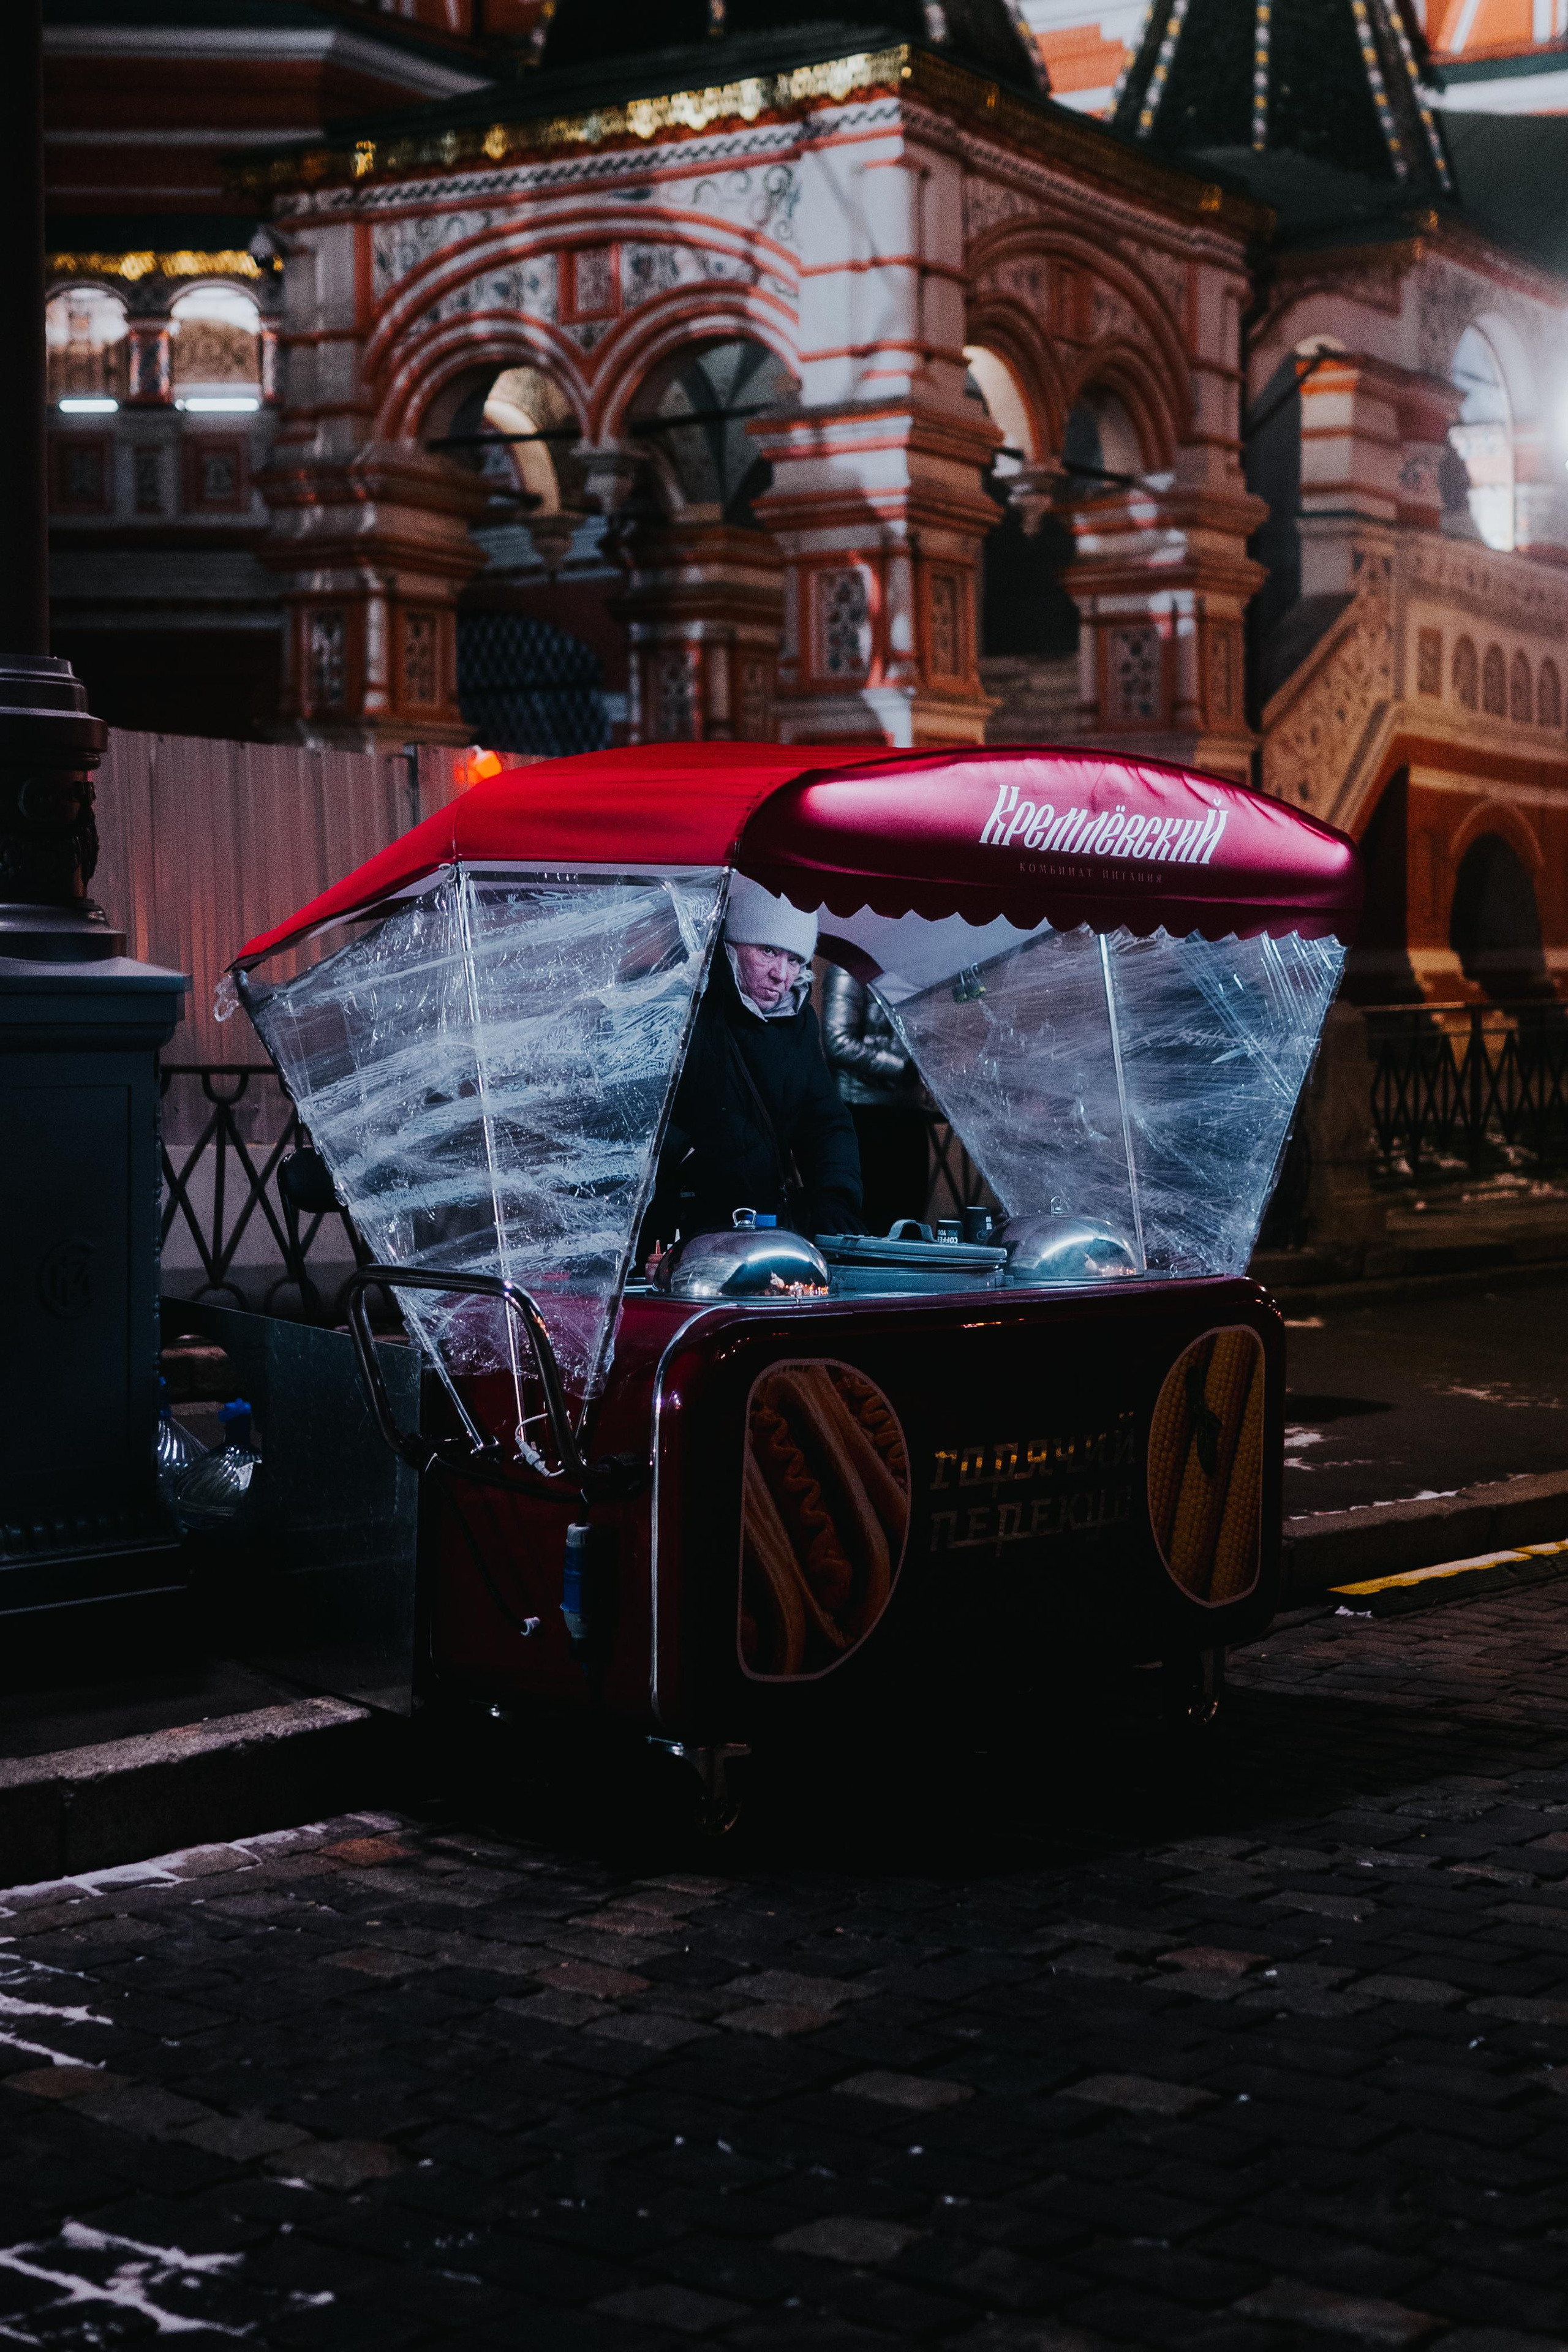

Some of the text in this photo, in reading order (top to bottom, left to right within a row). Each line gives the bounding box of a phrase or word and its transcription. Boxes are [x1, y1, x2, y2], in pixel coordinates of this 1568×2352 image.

[1019, 862, 1163, 883] КОМБИНАТ ПИТАНИЯ
[929, 1411, 1139, 1498] ГОРЯЧИЙ
[930, 1485, 1133, 1558] ПЕРЕКУС
